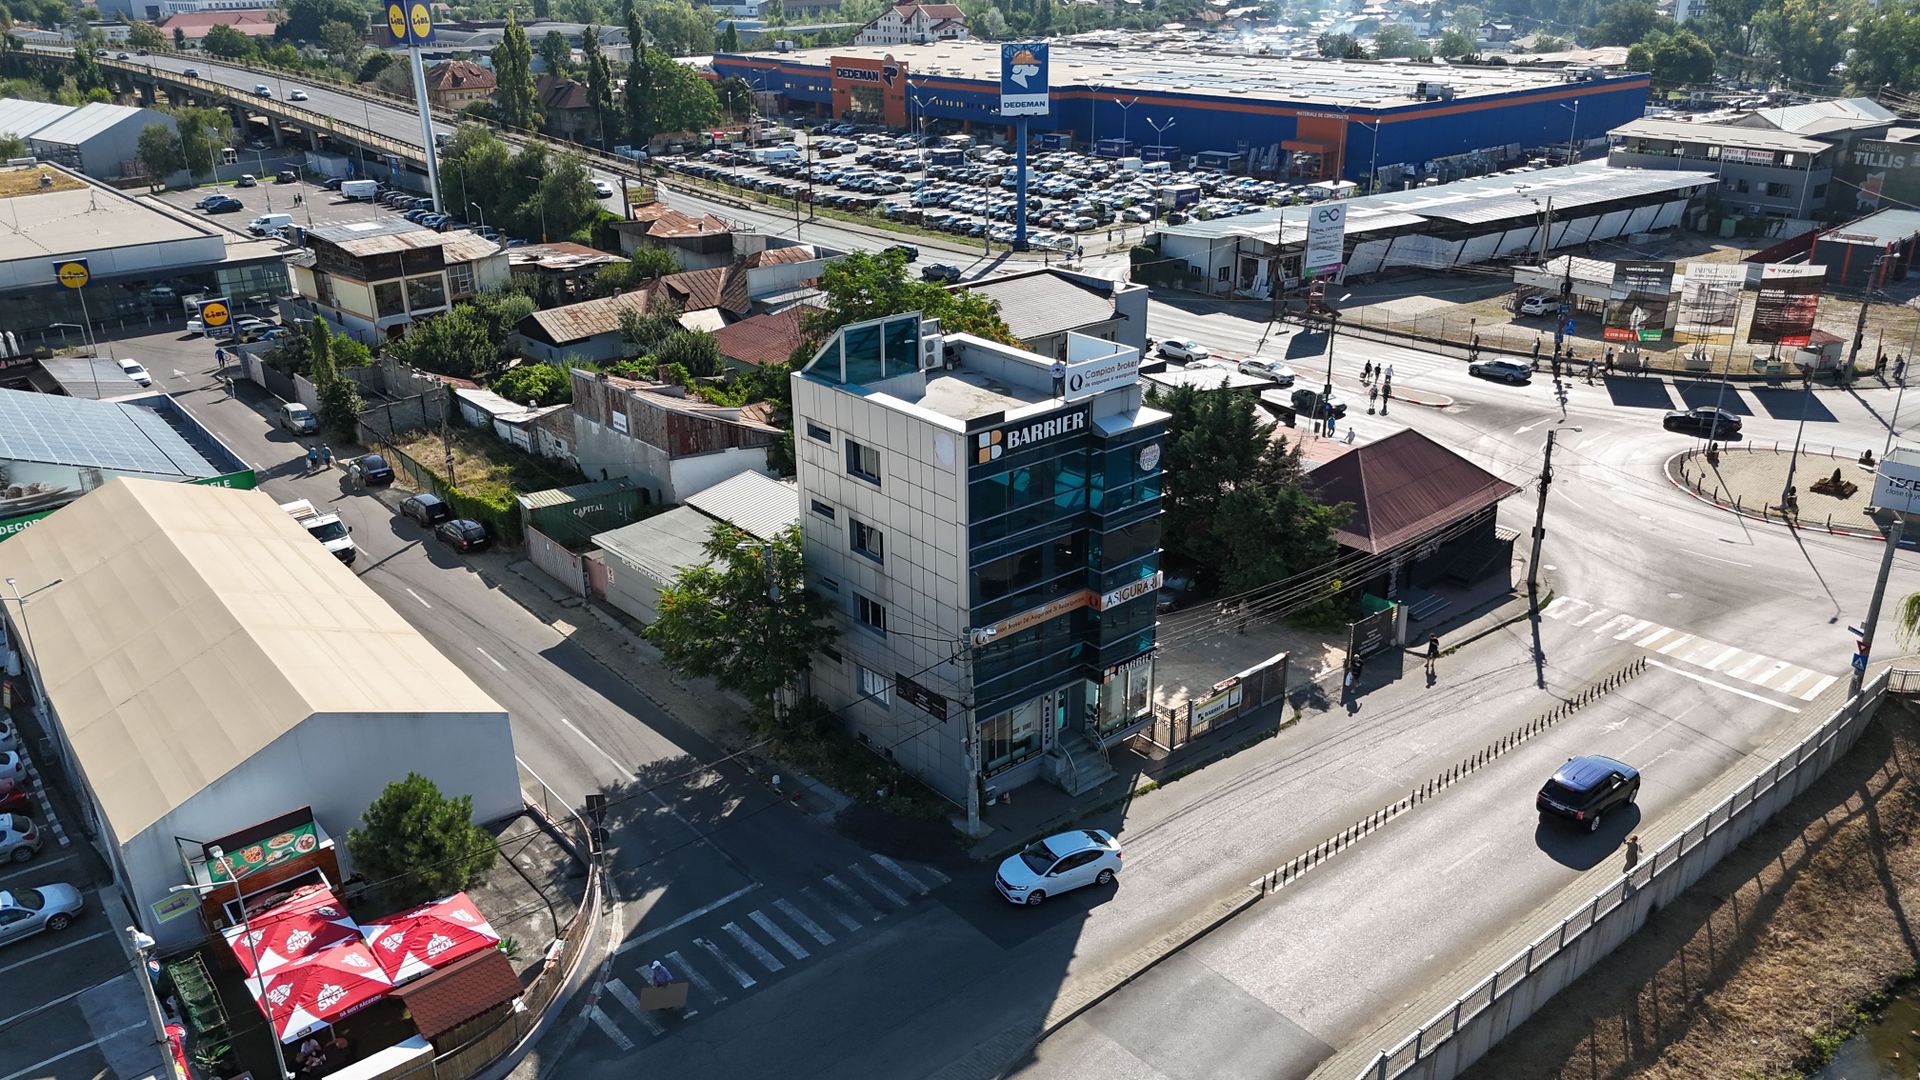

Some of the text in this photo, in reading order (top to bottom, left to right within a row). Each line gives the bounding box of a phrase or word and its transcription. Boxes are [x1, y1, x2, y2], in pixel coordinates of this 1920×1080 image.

[836, 67, 880, 82] DEDEMAN
[1854, 151, 1905, 168] TILLIS
[1084, 360, 1138, 379] Campion Broker
[1007, 411, 1084, 450] BARRIER
[573, 504, 604, 515] CAPITAL
[1118, 650, 1157, 675] BARRIER
[286, 934, 317, 954] SKOL
[427, 938, 457, 959] SKOL
[317, 988, 349, 1011] SKOL
